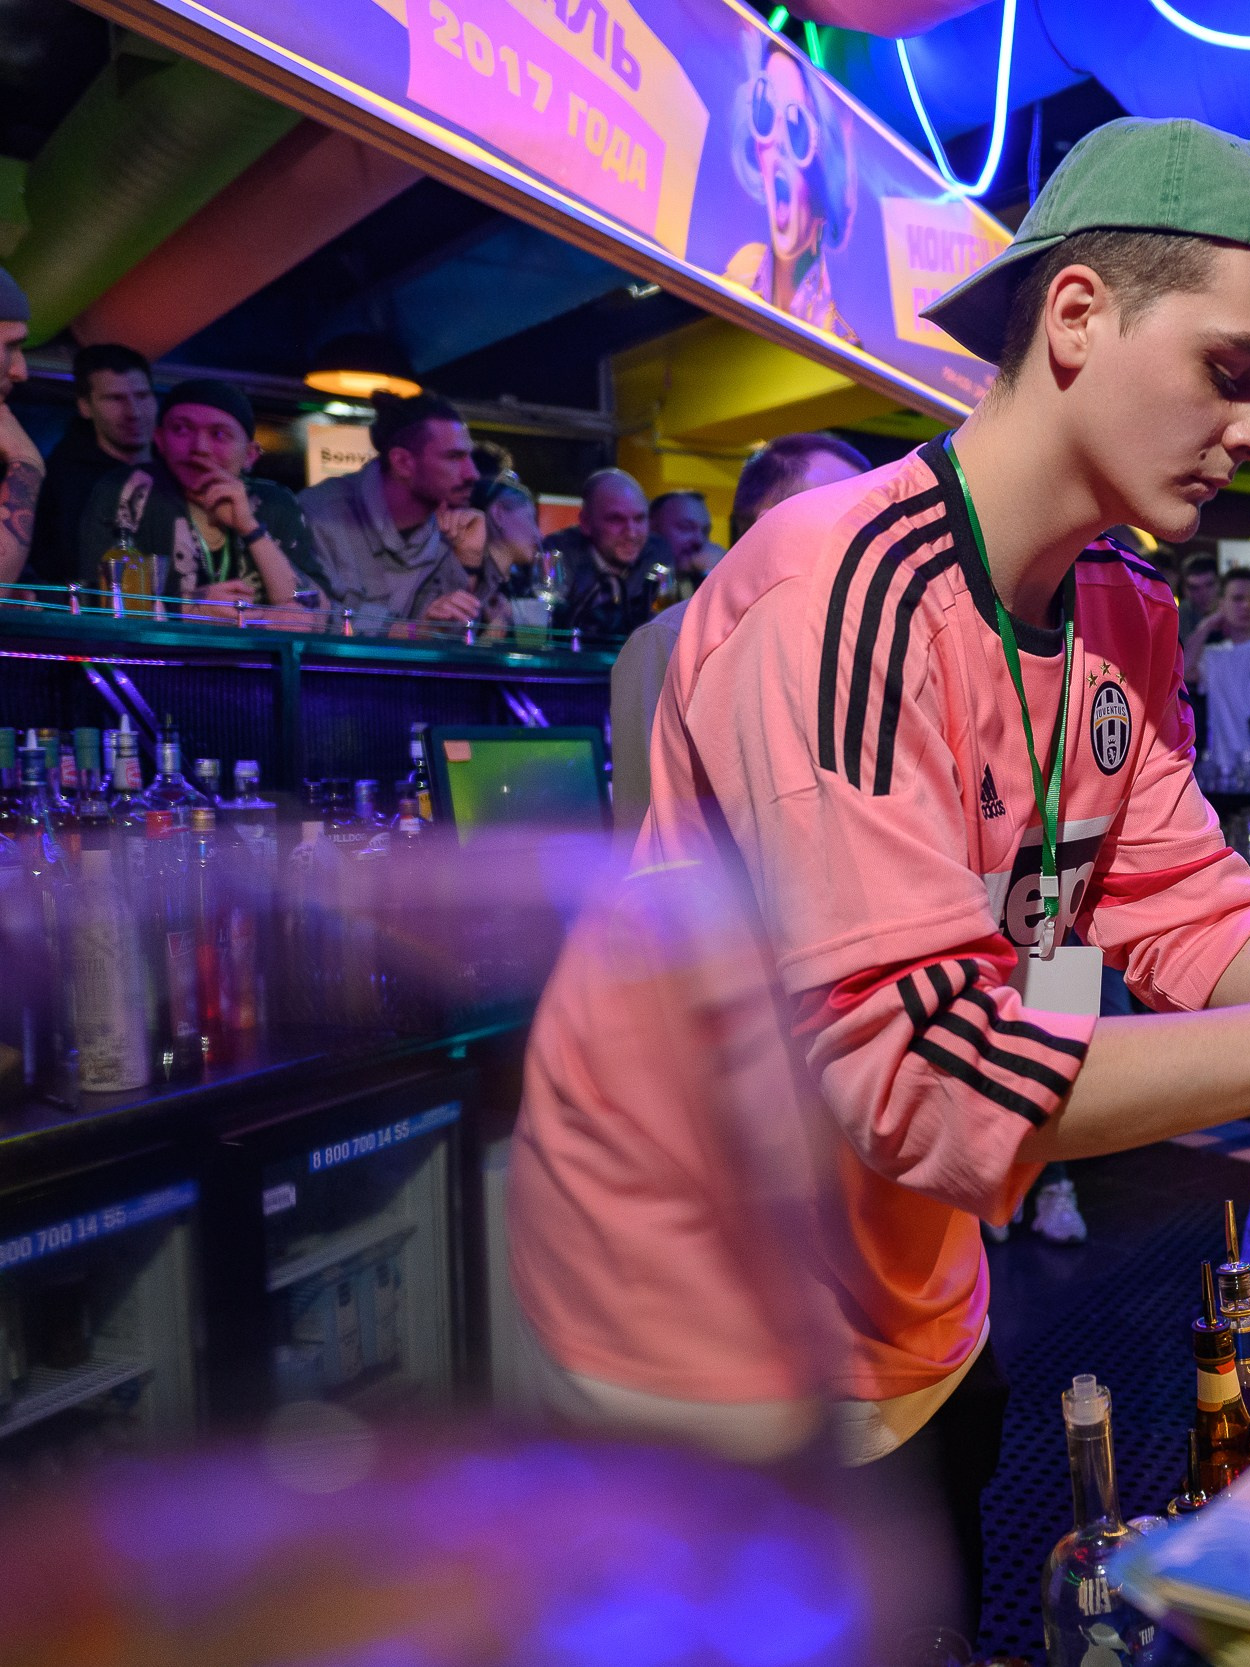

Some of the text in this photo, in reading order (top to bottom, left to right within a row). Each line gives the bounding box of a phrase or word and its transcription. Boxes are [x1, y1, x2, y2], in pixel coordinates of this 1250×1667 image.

[552, 0, 641, 92] ЛЬ
[429, 0, 647, 192] 2017 ГОДА
[1096, 705, 1127, 720] JUVENTUS
[981, 800, 1006, 820] adidas
[999, 861, 1095, 947] ep
[313, 1120, 410, 1169] 8 800 700 14 55
[36, 1223, 73, 1255] 700
[78, 1214, 98, 1239] 14
